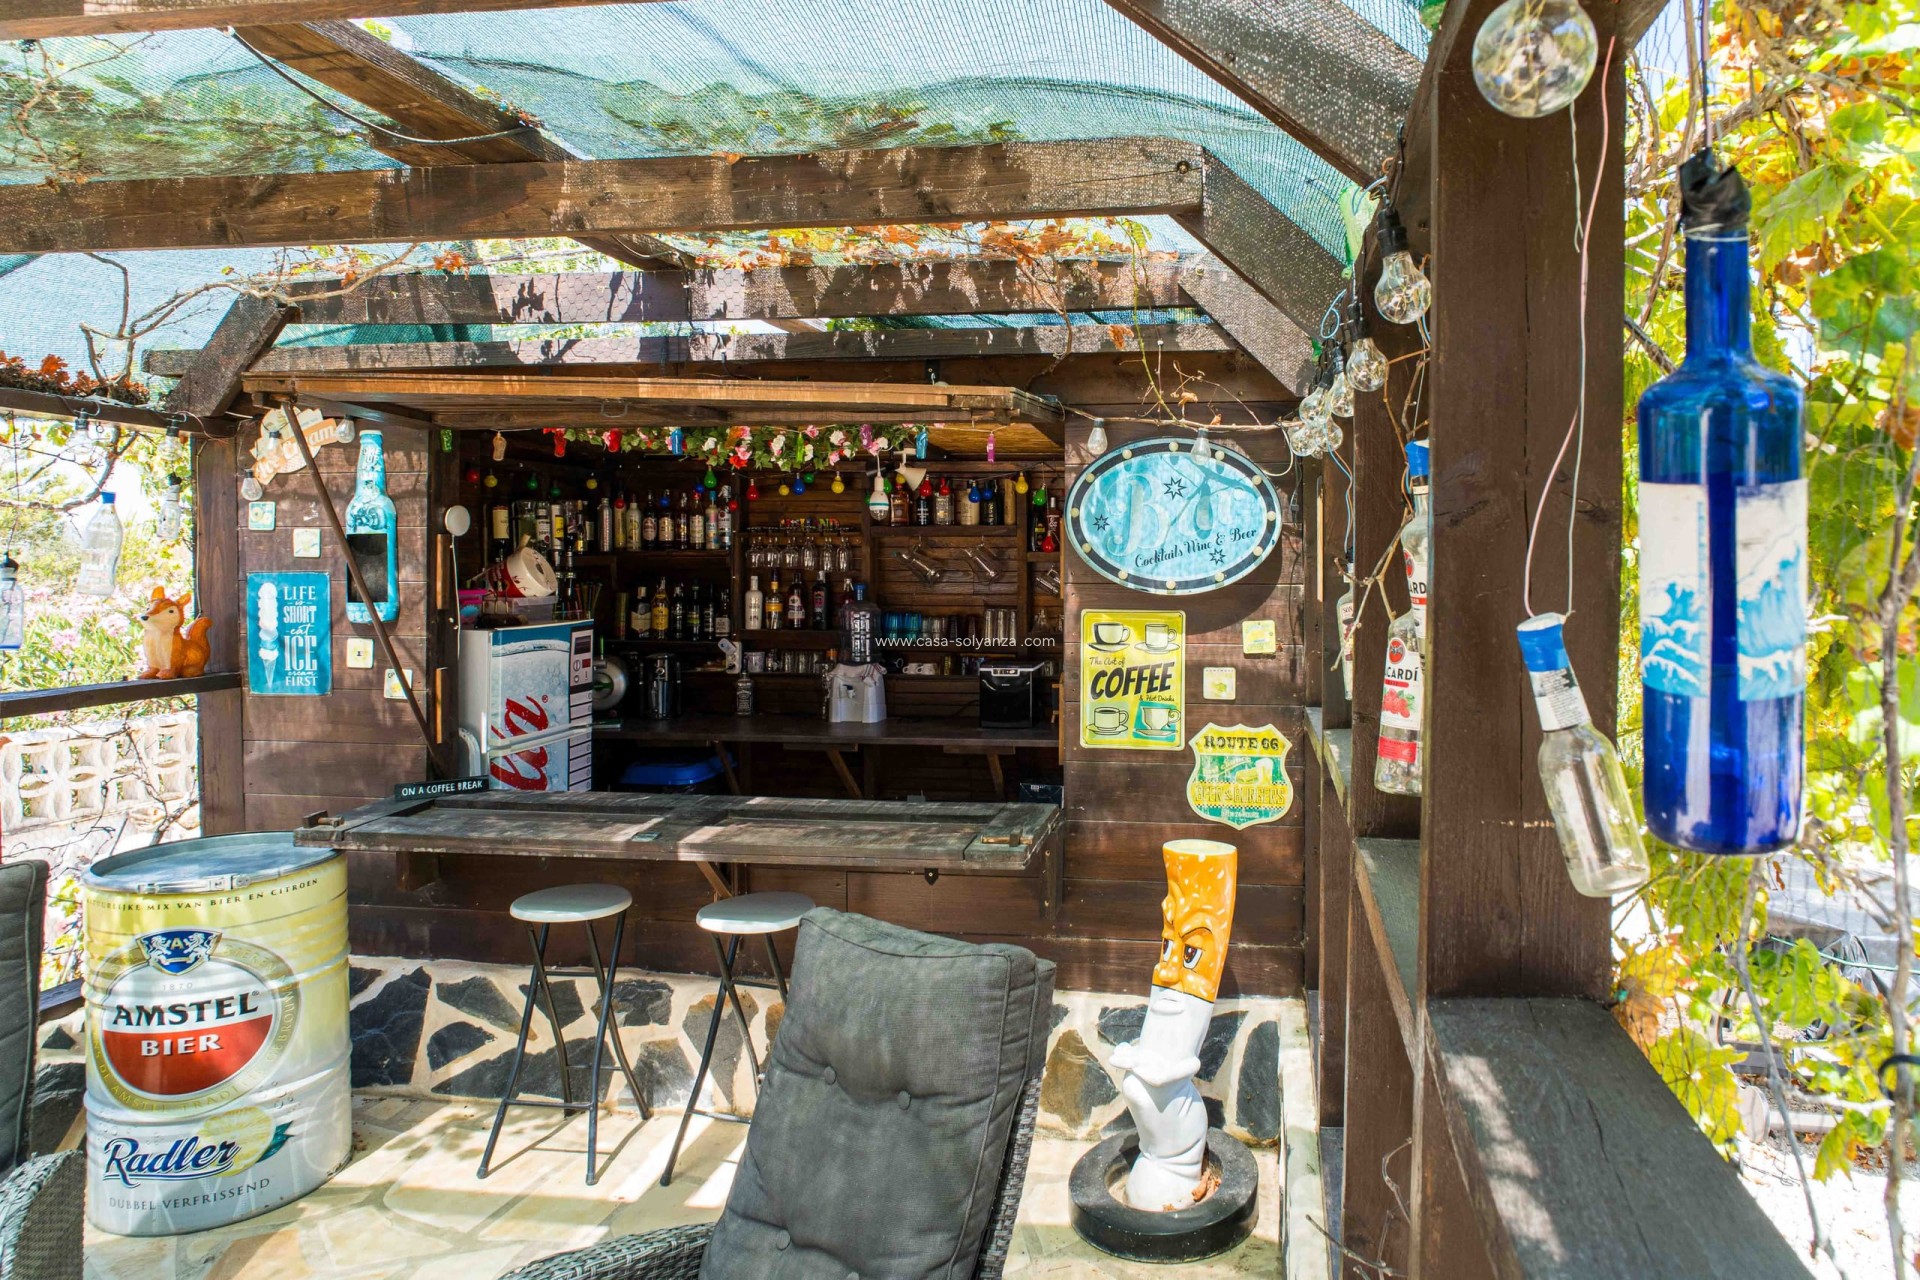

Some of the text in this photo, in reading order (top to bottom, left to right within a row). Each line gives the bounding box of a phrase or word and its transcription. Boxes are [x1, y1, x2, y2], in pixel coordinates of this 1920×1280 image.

[1134, 544, 1184, 568] Cocktails
[1184, 537, 1213, 555] Wine
[1229, 527, 1257, 542] Beer
[284, 585, 317, 600] LIFE
[283, 605, 318, 624] SHORT
[290, 623, 315, 636] eat
[284, 635, 318, 671] ICE
[1089, 656, 1126, 667] The Art of
[285, 676, 319, 687] FIRST
[1090, 661, 1175, 700] COFFEE
[1203, 735, 1280, 751] ROUTE 66
[401, 780, 483, 796] ON A COFFEE BREAK
[1195, 784, 1222, 802] BEER
[146, 902, 170, 911] MIX
[177, 901, 202, 909] VAN
[210, 896, 241, 907] BIER
[249, 892, 264, 900] EN
[271, 878, 318, 896] CITROEN
[170, 937, 184, 950] A
[162, 982, 193, 991] 1870
[112, 992, 259, 1027] AMSTEL
[141, 1034, 223, 1058] BIER
[104, 1135, 242, 1189] Radler
[109, 1178, 270, 1211] DUBBEL VERFRISSEND
